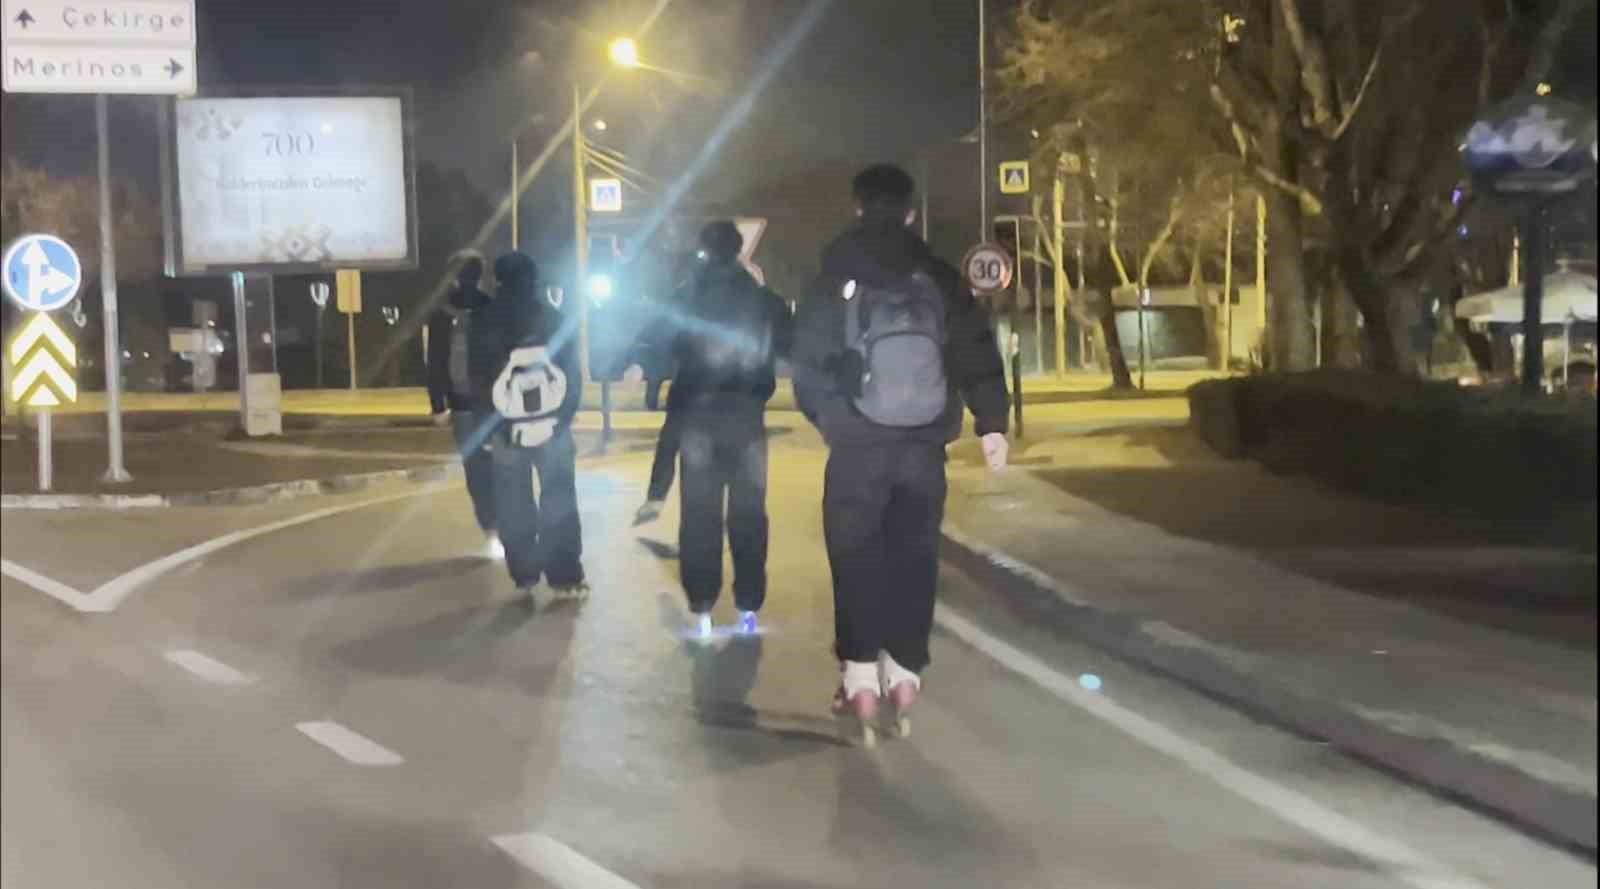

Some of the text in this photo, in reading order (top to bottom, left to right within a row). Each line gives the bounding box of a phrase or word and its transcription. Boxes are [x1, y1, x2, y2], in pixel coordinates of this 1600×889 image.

[62, 6, 184, 32] Çekirge
[13, 57, 143, 77] Merinos
[261, 130, 315, 157] 700
[973, 259, 1000, 281] 30
